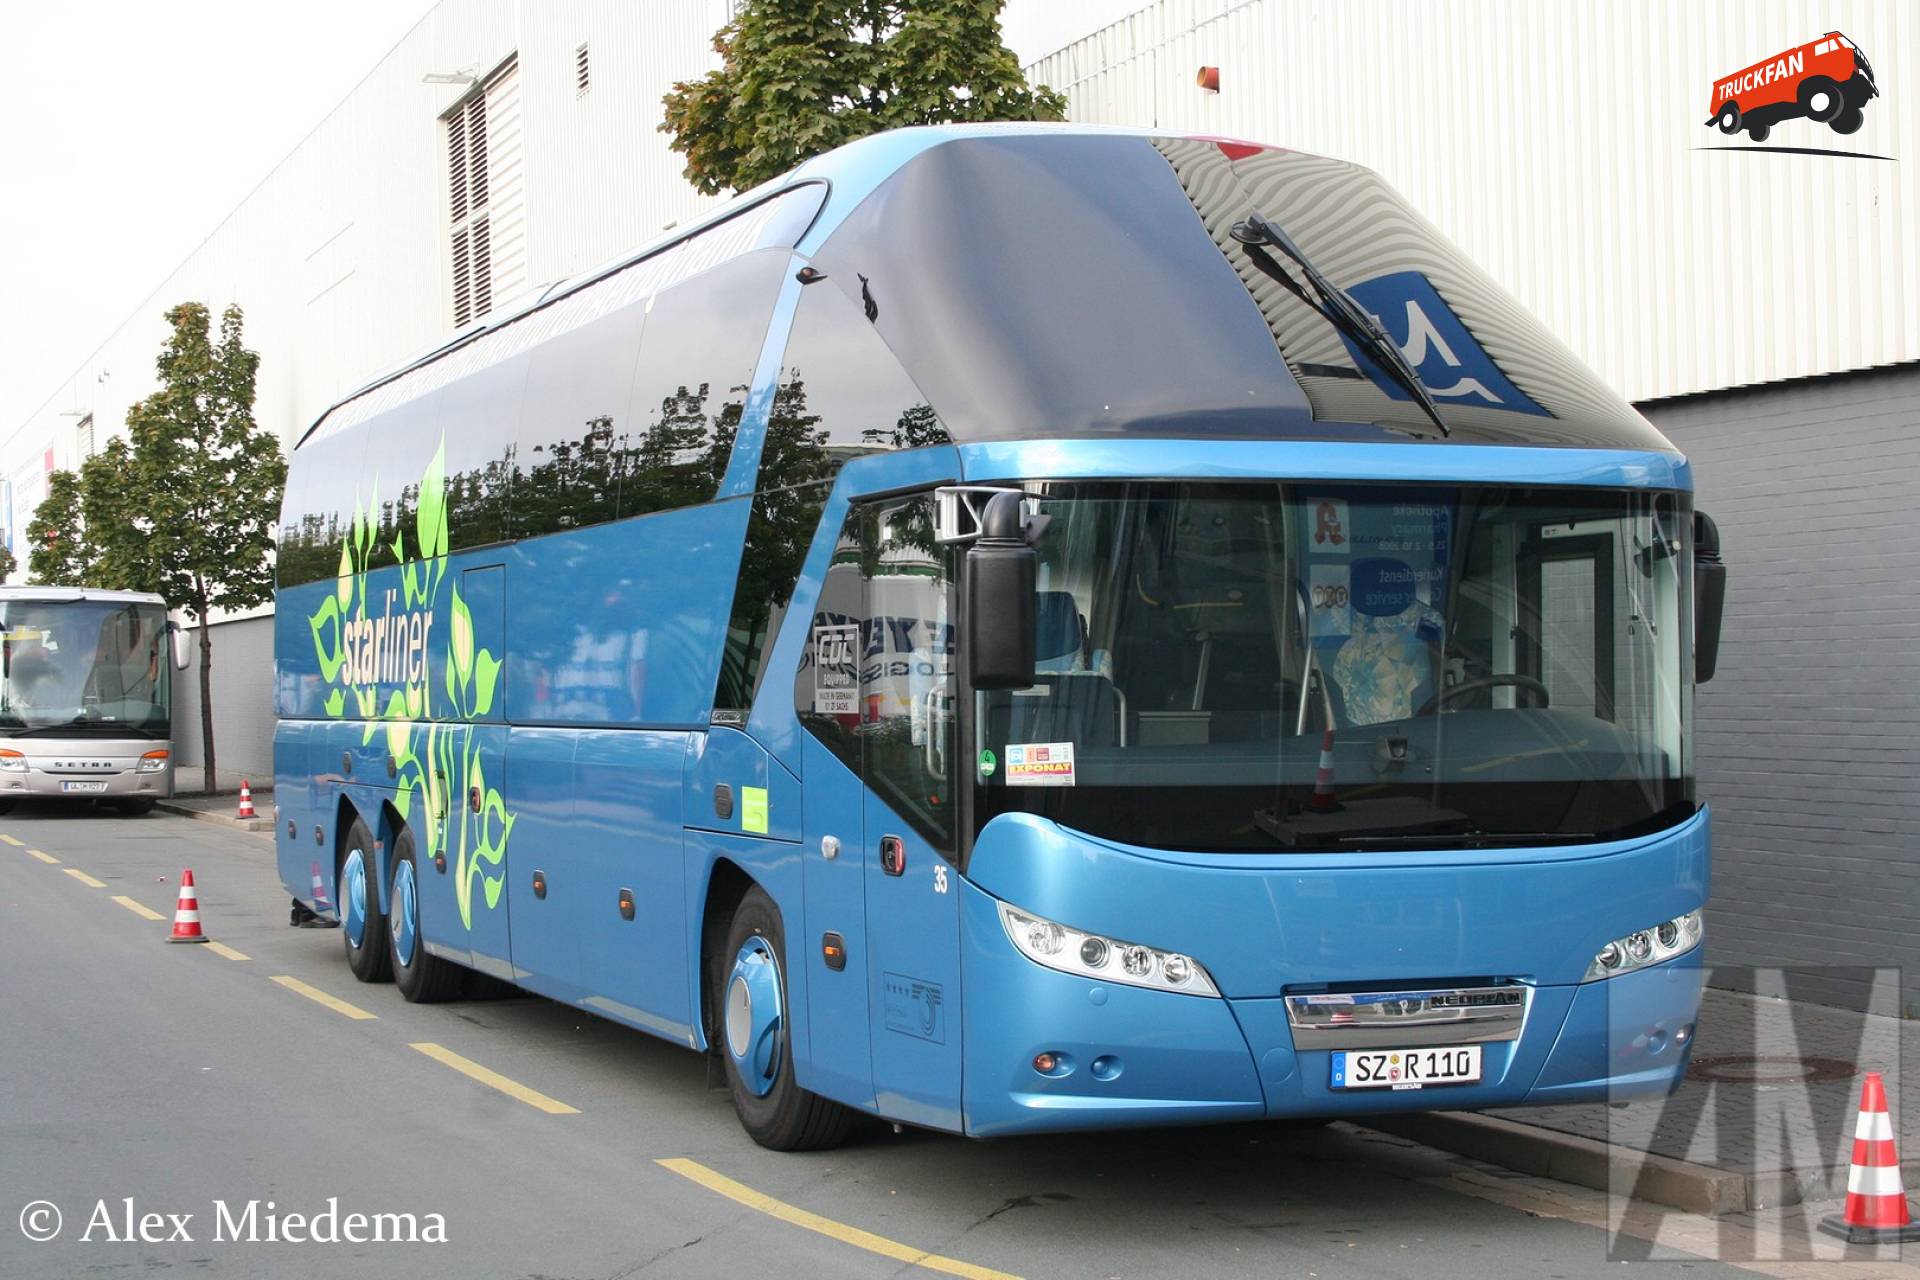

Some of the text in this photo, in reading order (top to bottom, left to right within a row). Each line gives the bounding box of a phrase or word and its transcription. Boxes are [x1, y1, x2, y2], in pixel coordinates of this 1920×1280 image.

[342, 588, 433, 686] starliner
[1009, 762, 1072, 775] EXPONAT
[934, 864, 948, 894] 35
[1355, 1051, 1470, 1082] SZ R 110
